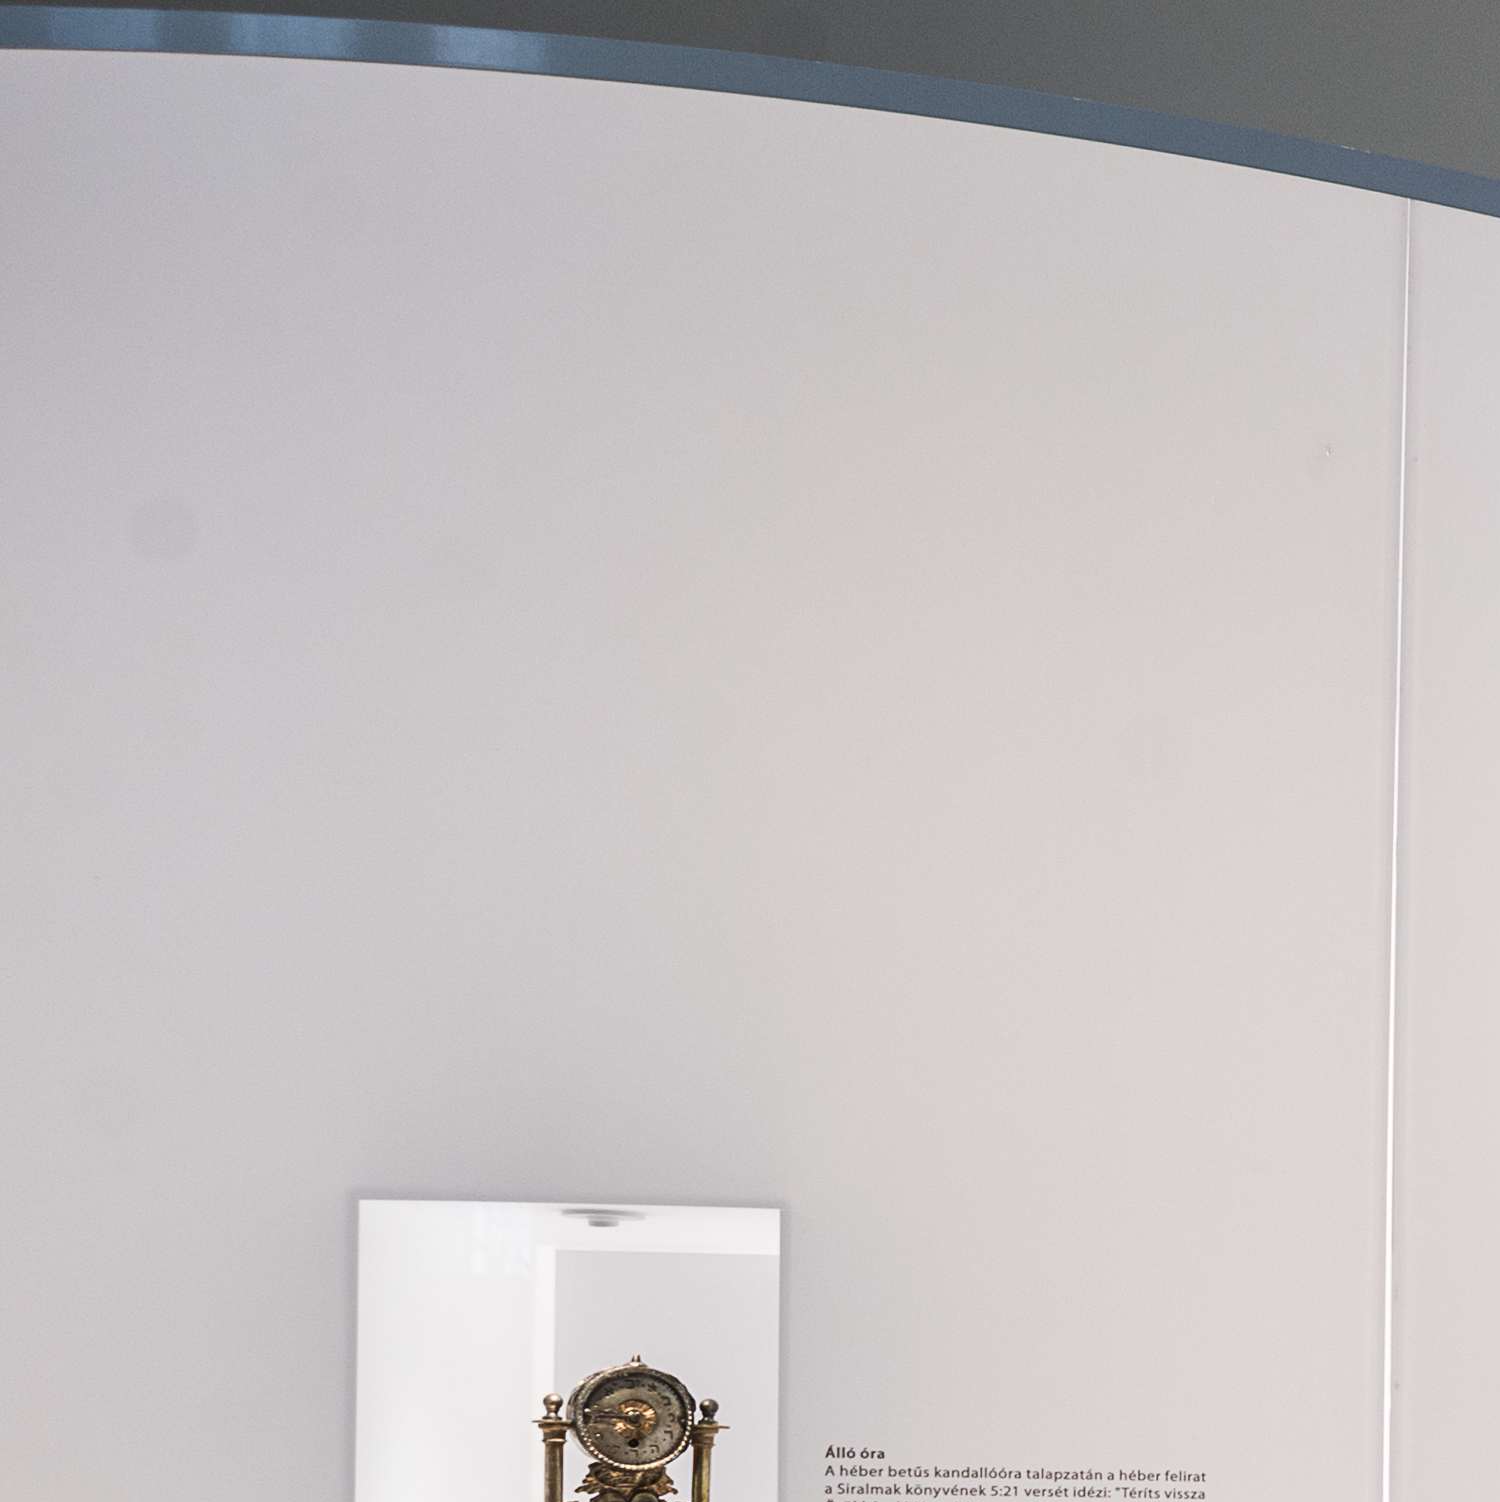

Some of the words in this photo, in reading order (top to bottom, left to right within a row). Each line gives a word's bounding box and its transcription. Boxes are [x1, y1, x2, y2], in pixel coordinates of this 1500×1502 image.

[825, 1445, 855, 1458] Álló
[860, 1447, 885, 1459] óra
[825, 1466, 835, 1476] A
[840, 1466, 883, 1477] héber
[888, 1466, 929, 1477] betűs
[934, 1467, 1021, 1479] kandallóóra
[1027, 1469, 1102, 1482] talapzatán
[1108, 1473, 1114, 1481] a
[1120, 1470, 1160, 1481] héber
[1165, 1471, 1205, 1482] felirat
[825, 1486, 832, 1494] a
[837, 1484, 901, 1495] Siralmak
[906, 1485, 986, 1498] könyvének
[991, 1486, 1018, 1496] 5:21
[1024, 1487, 1068, 1498] versét
[1074, 1487, 1111, 1498] idézi:
[1165, 1489, 1205, 1500] vissza
